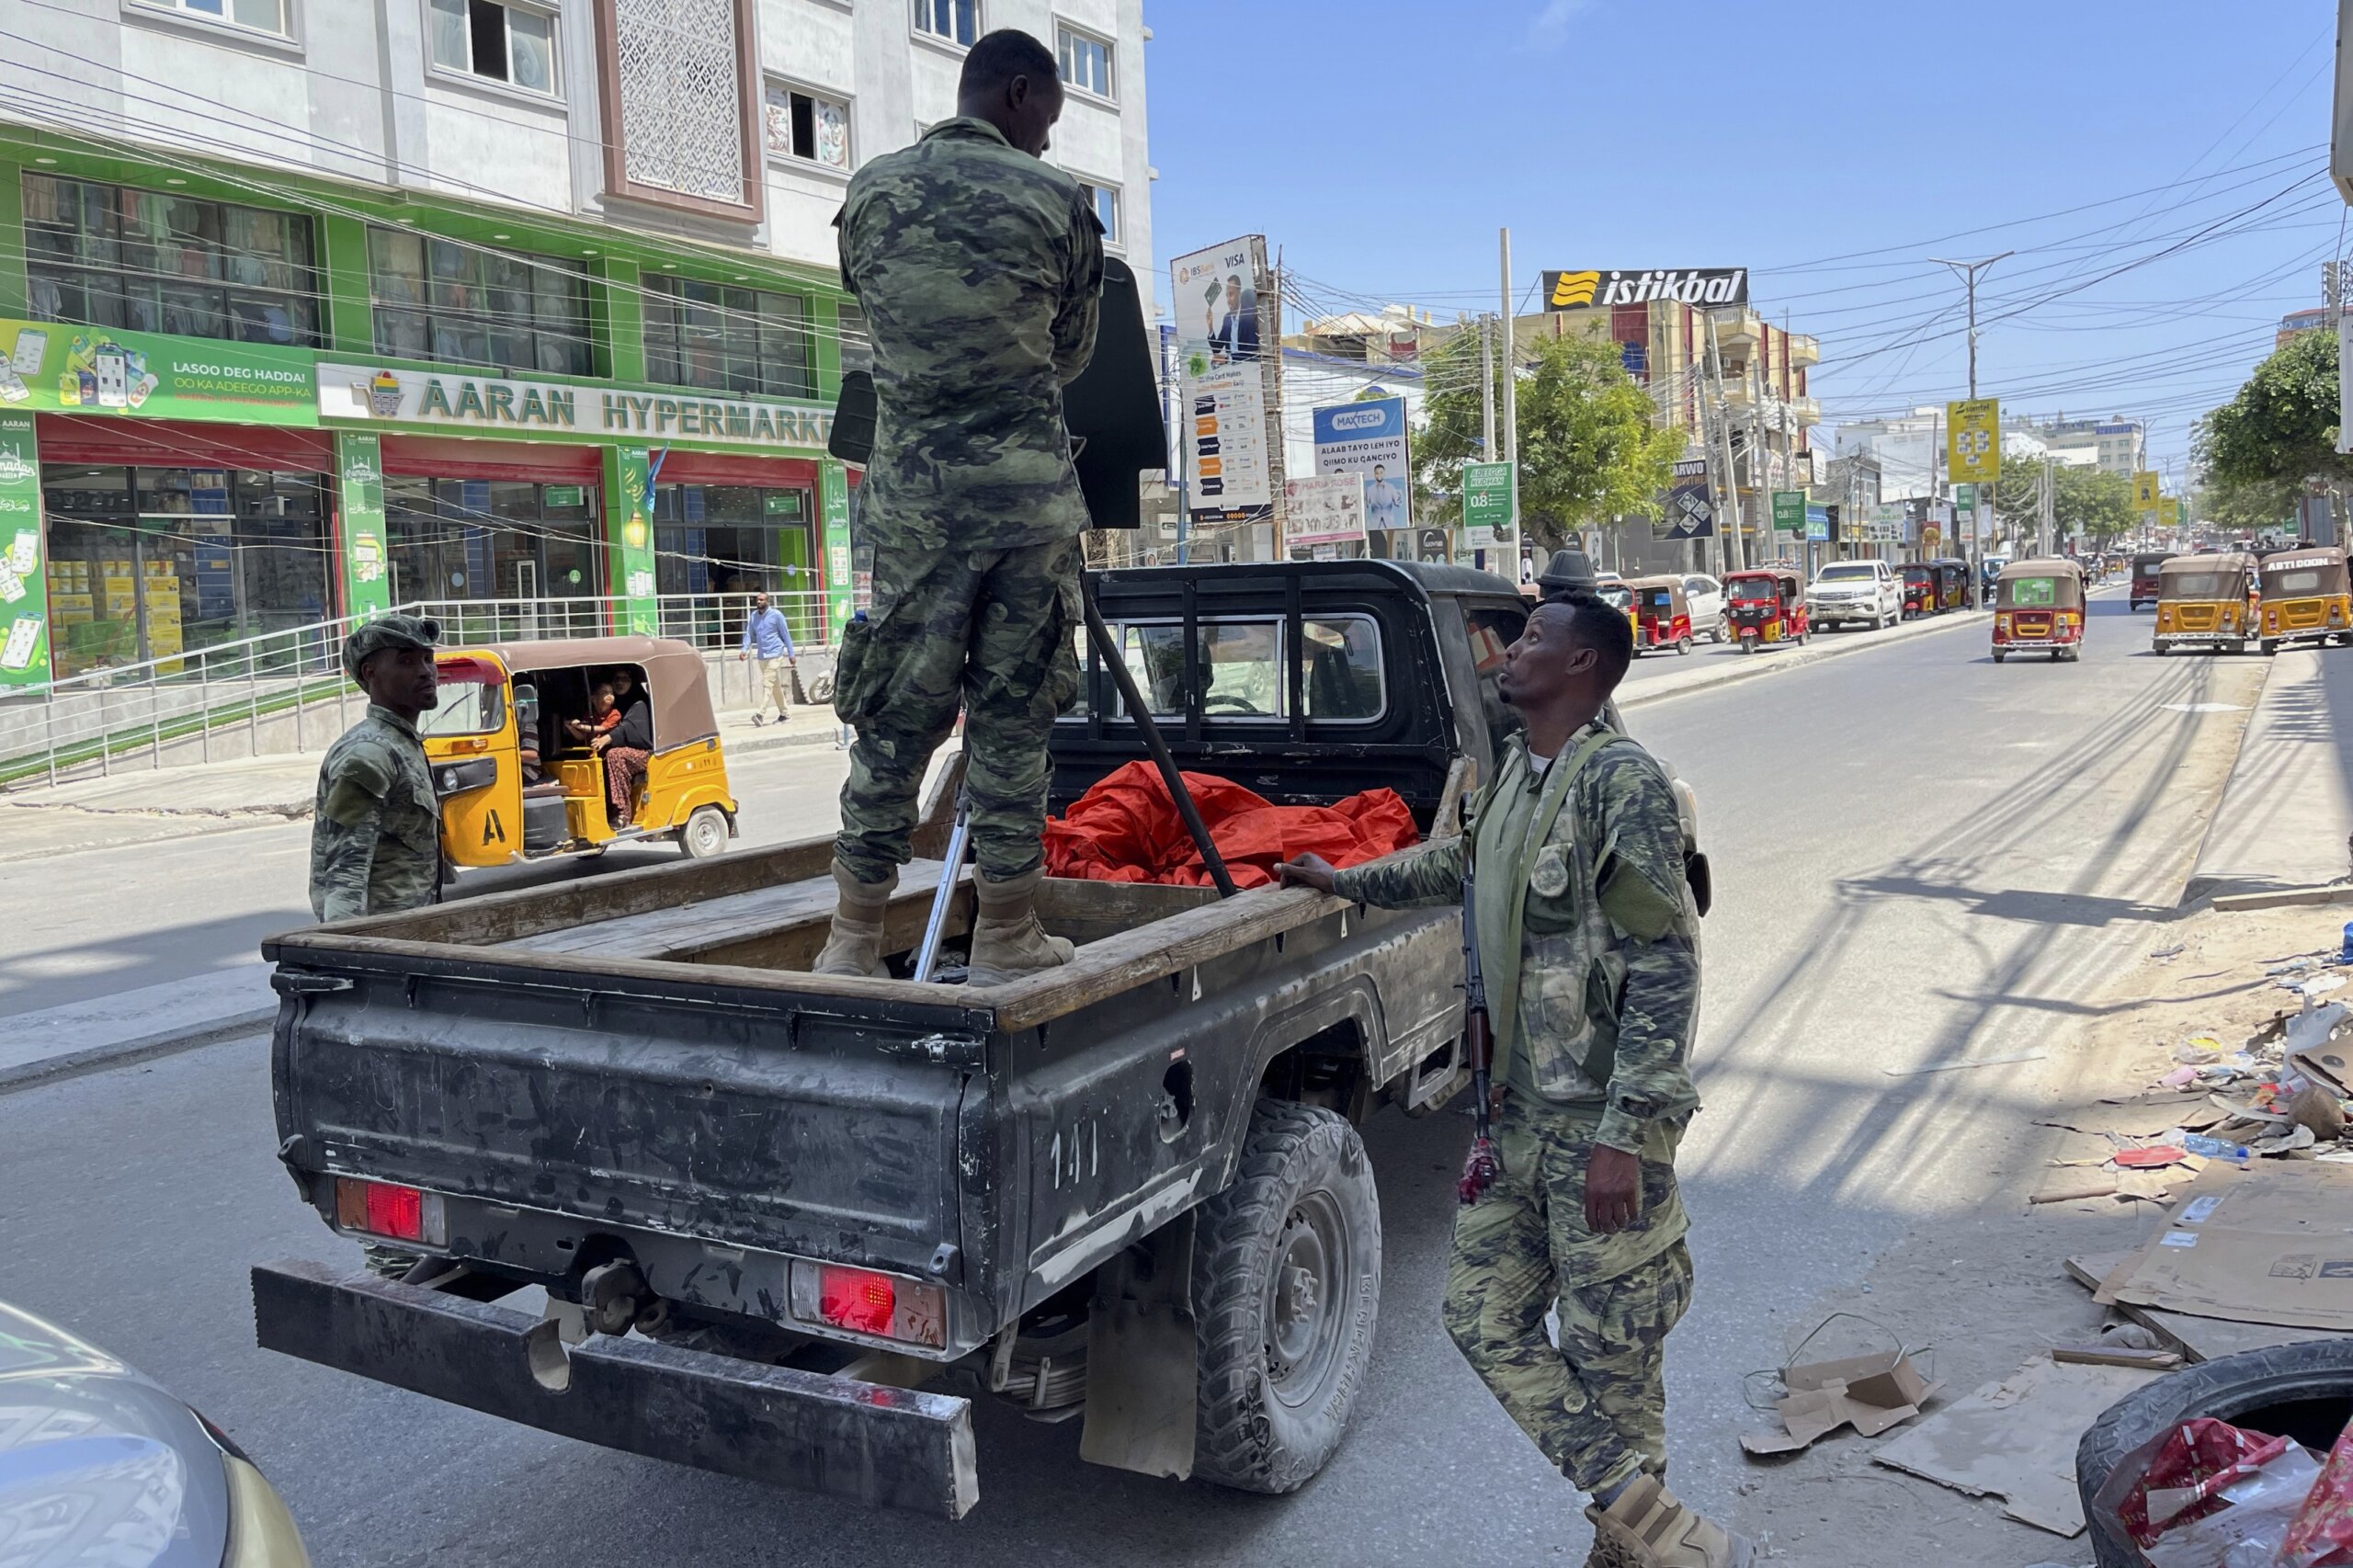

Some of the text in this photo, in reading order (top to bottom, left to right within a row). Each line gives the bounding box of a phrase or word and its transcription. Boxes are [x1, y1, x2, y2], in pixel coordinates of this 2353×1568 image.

[1225, 253, 1245, 268] VISA
[1602, 270, 1744, 305] istikbal
[173, 361, 305, 382] LASOO DEG HADDA!
[174, 378, 312, 397] OO KA ADEEGO APP-KA
[418, 379, 574, 426] AARAN
[1337, 412, 1381, 428] MAXTECH
[1321, 446, 1346, 455] ALAAB
[1348, 443, 1369, 451] TAYO
[1370, 441, 1384, 449] LEH
[1324, 458, 1346, 467] QIIMO
[1471, 467, 1507, 478] ADEEGGA
[1302, 478, 1356, 490] MARIA ROSE
[1471, 477, 1505, 487] KUDHAN
[2268, 558, 2329, 571] ABTI DOON
[482, 809, 506, 846] A
